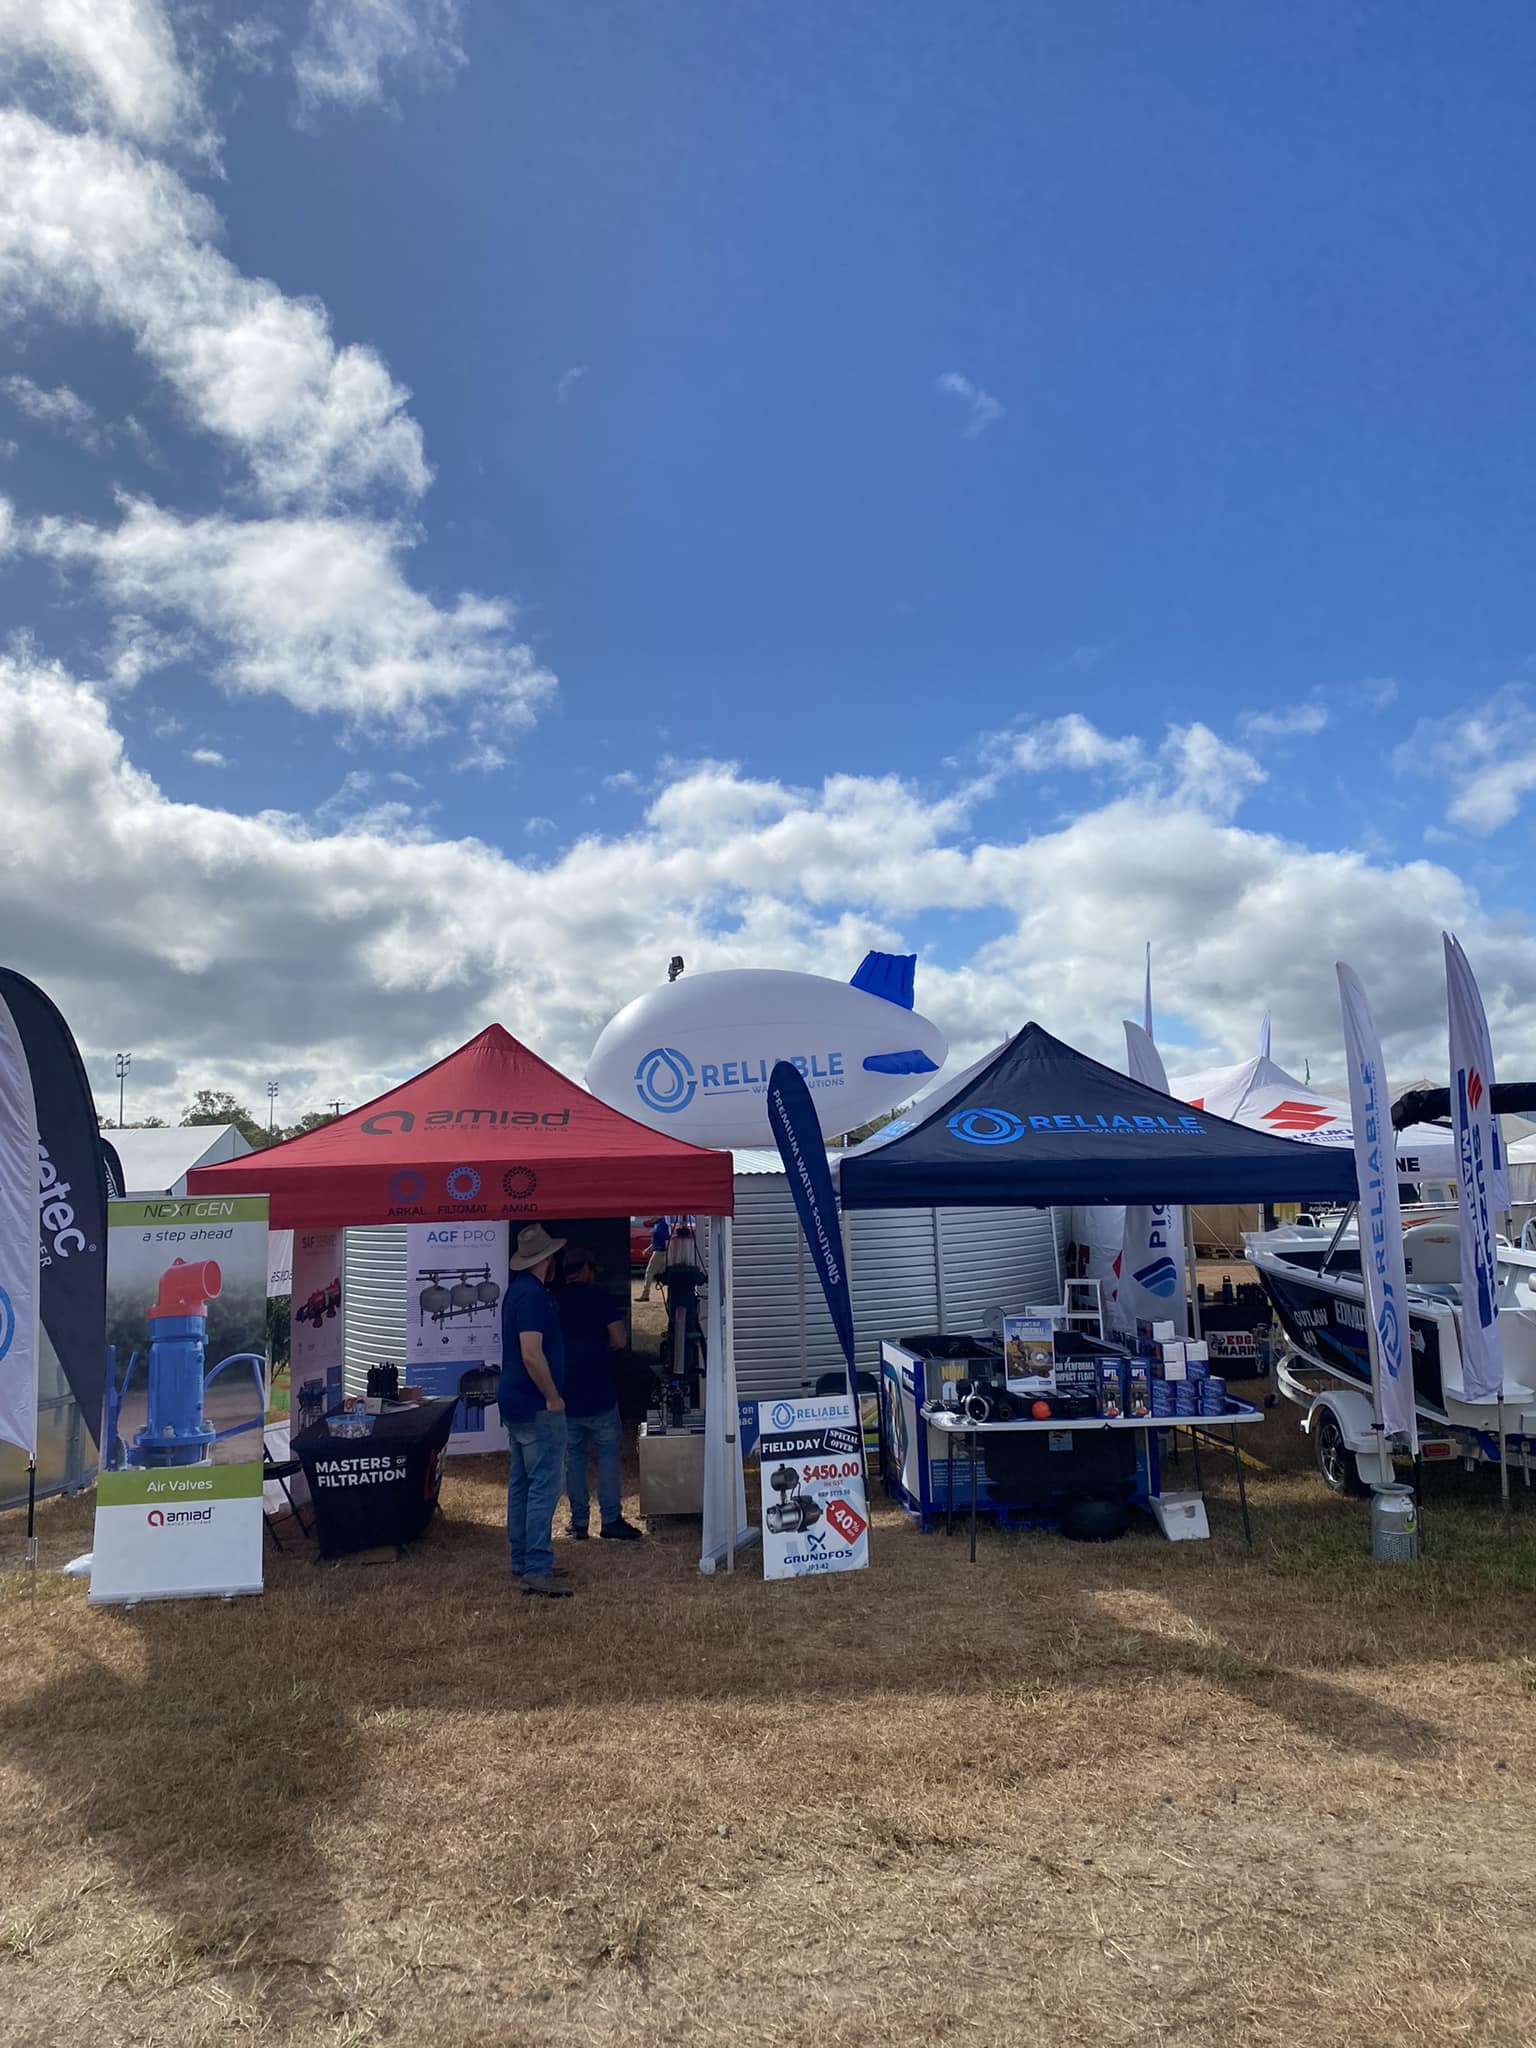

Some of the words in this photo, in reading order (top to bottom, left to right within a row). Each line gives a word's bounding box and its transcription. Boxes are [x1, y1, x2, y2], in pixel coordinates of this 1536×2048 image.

[701, 1053, 844, 1087] RELIBLE
[808, 1078, 845, 1089] UTIONS
[425, 1109, 570, 1126] amiad
[1028, 1115, 1203, 1129] RELIABLE
[1292, 1129, 1354, 1139] UZUKI
[1360, 1061, 1386, 1275] RELIABLE
[773, 1089, 799, 1156] PREMIUM
[797, 1157, 816, 1206] WATER
[812, 1207, 842, 1285] SOLUTIONS
[143, 1202, 234, 1218] NEXTGEN
[437, 1204, 488, 1215] FILTOMAT
[501, 1203, 538, 1213] AMIAD
[142, 1232, 152, 1242] a
[155, 1229, 186, 1243] step
[190, 1227, 233, 1241] ahead
[426, 1231, 459, 1243] AGF
[463, 1230, 496, 1242] PRO
[1227, 1335, 1254, 1345] EDG
[1217, 1346, 1258, 1356] MARIN
[797, 1405, 850, 1419] RELIABLE
[762, 1440, 798, 1454] FIELD
[796, 1438, 821, 1450] DAY
[315, 1457, 391, 1473] MASTERS
[803, 1462, 860, 1484] $450.00
[317, 1467, 407, 1488] FILTRATION
[146, 1481, 167, 1493] Air
[168, 1479, 214, 1492] Valves
[166, 1506, 212, 1523] amiad
[783, 1549, 853, 1565] GRUNDFOS
